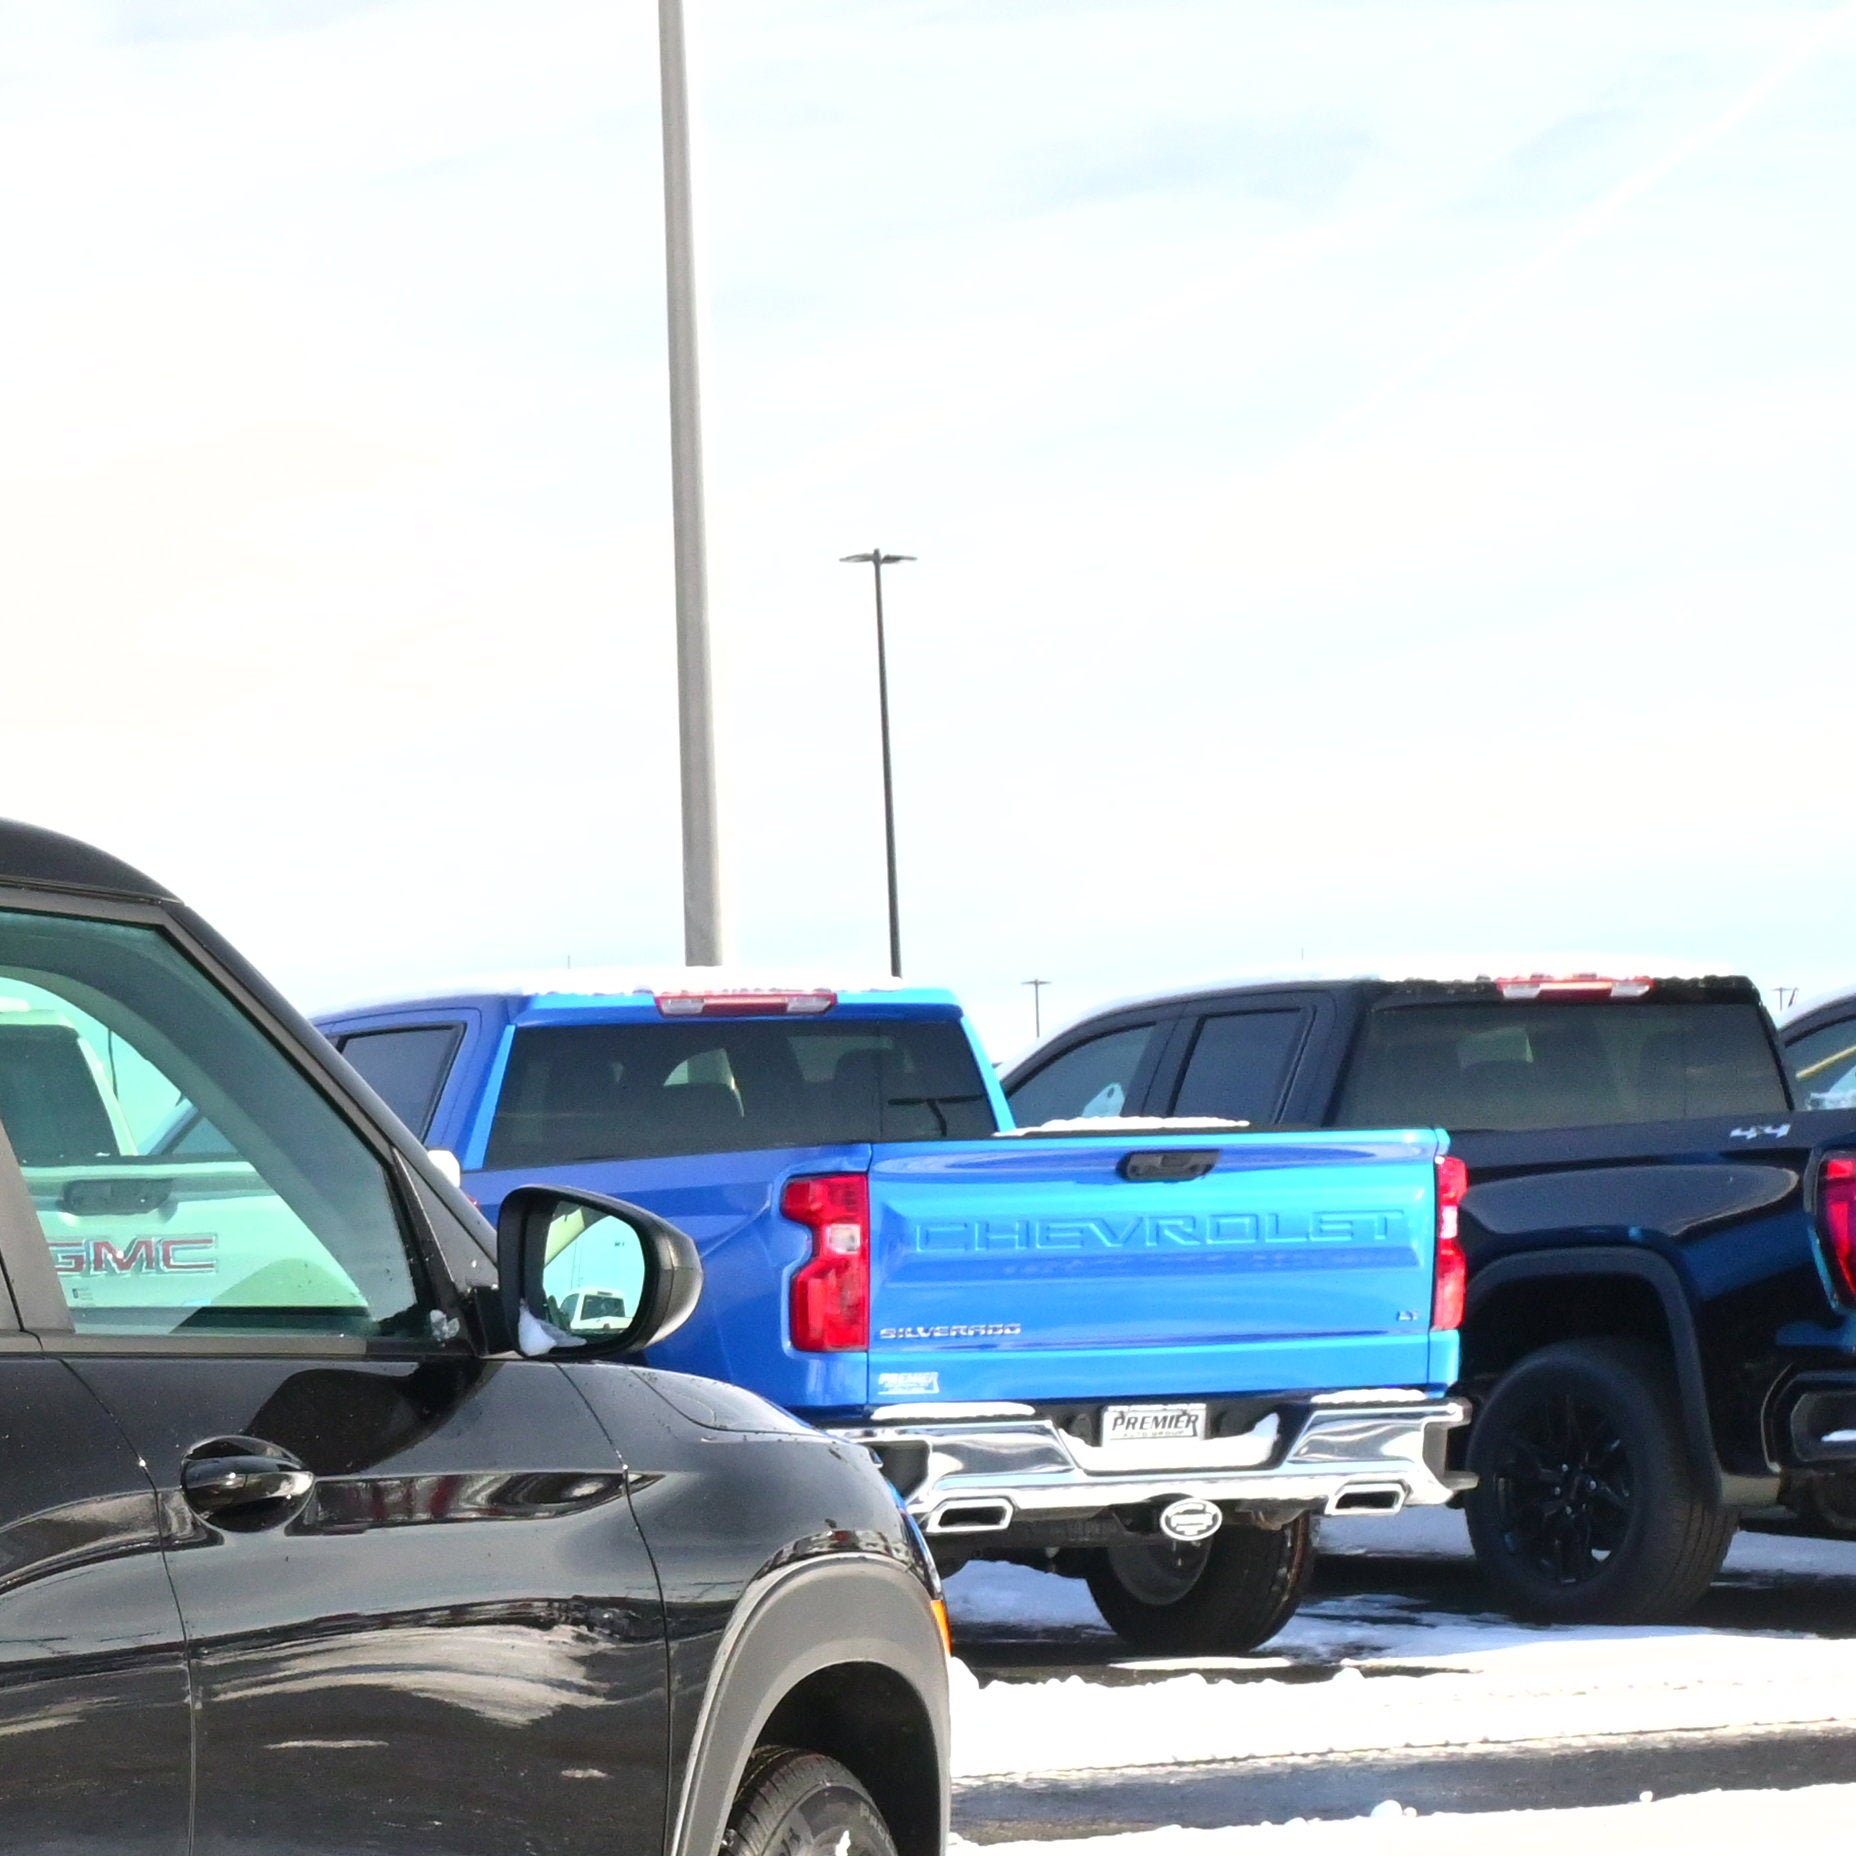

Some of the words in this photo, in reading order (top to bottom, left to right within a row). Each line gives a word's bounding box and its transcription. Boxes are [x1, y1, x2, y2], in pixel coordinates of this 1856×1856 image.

[915, 1210, 1404, 1252] CHEVROLET
[47, 1233, 218, 1276] GMC
[879, 1323, 1022, 1339] SILVERADO
[1112, 1414, 1199, 1431] PREMIER
